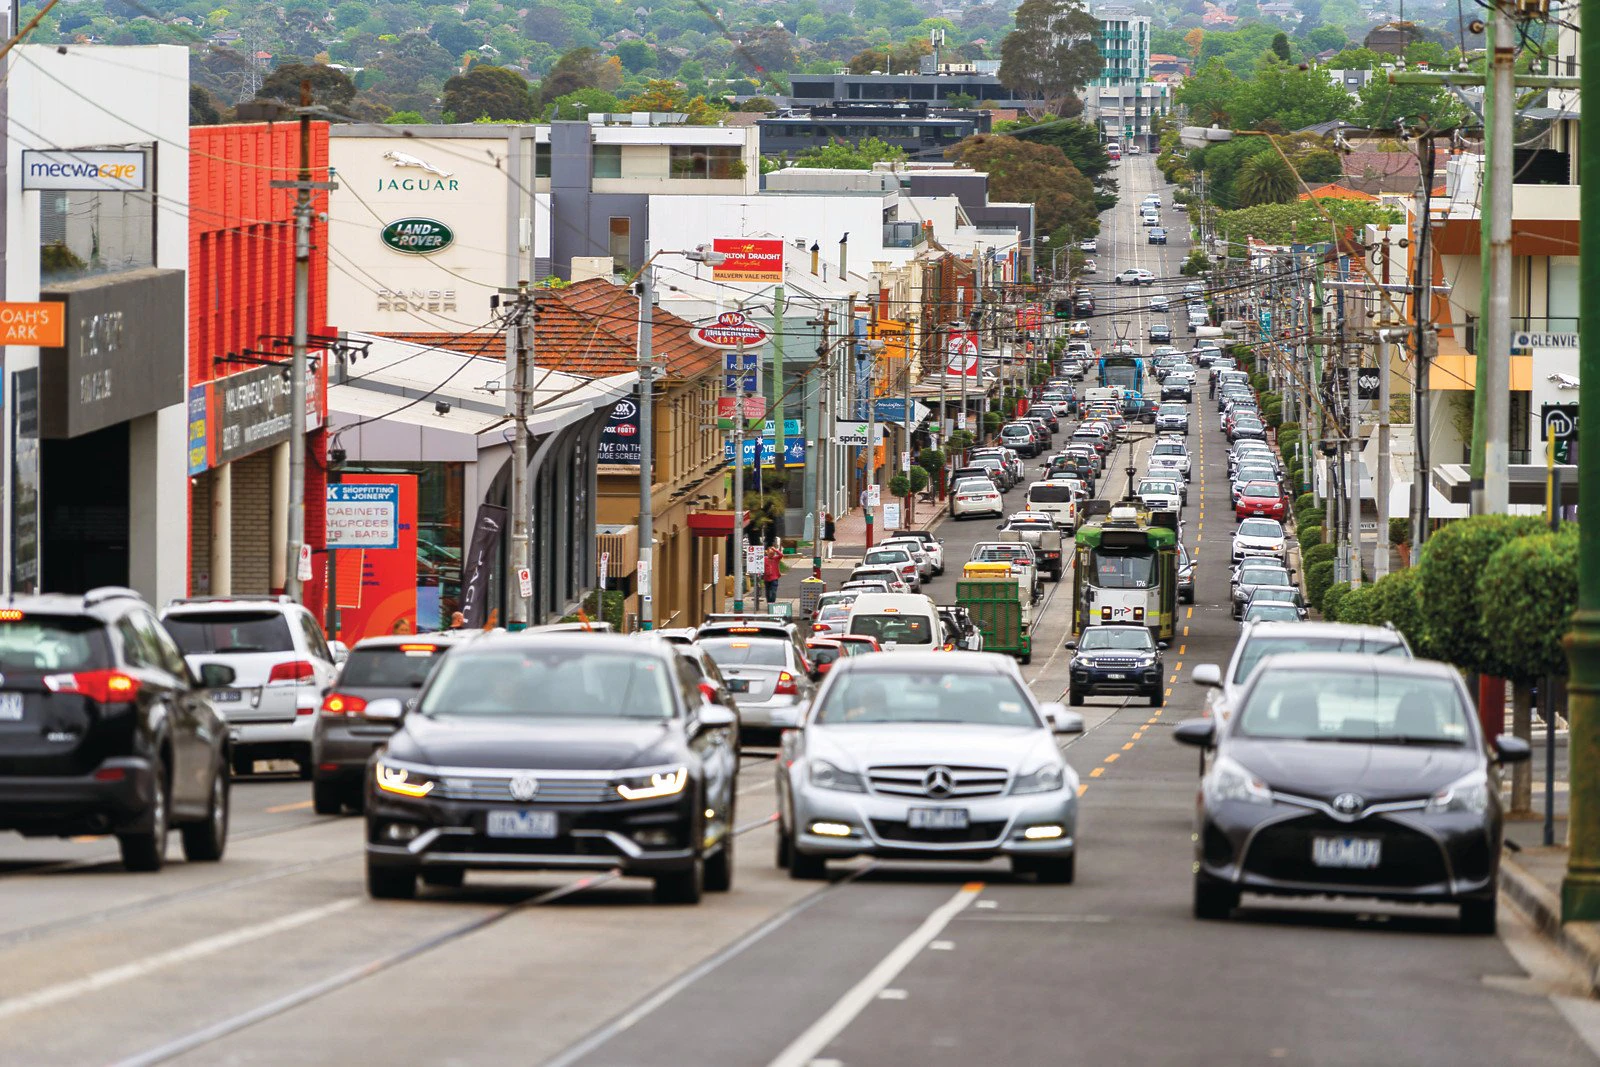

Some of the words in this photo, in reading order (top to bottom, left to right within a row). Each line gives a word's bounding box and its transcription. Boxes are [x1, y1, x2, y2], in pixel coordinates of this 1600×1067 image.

[30, 162, 137, 180] mecwacare
[377, 178, 460, 193] JAGUAR
[397, 223, 431, 235] LAND
[399, 235, 443, 247] ROVER
[748, 252, 781, 260] DRAUGHT
[377, 288, 457, 299] RANGE
[377, 301, 458, 313] ROVER
[0, 309, 49, 324] OAH'S
[721, 314, 742, 325] MVH
[6, 325, 38, 339] ARK
[1531, 335, 1579, 347] GLENVIE
[615, 403, 630, 413] OX
[839, 434, 868, 444] spring
[598, 442, 615, 452] IVE
[616, 443, 628, 452] ON
[629, 443, 641, 452] TH
[342, 486, 395, 494] SHOPFITTING
[327, 507, 389, 516] CABINETS
[326, 519, 389, 528] ARDROBES
[462, 550, 483, 624] JAGU
